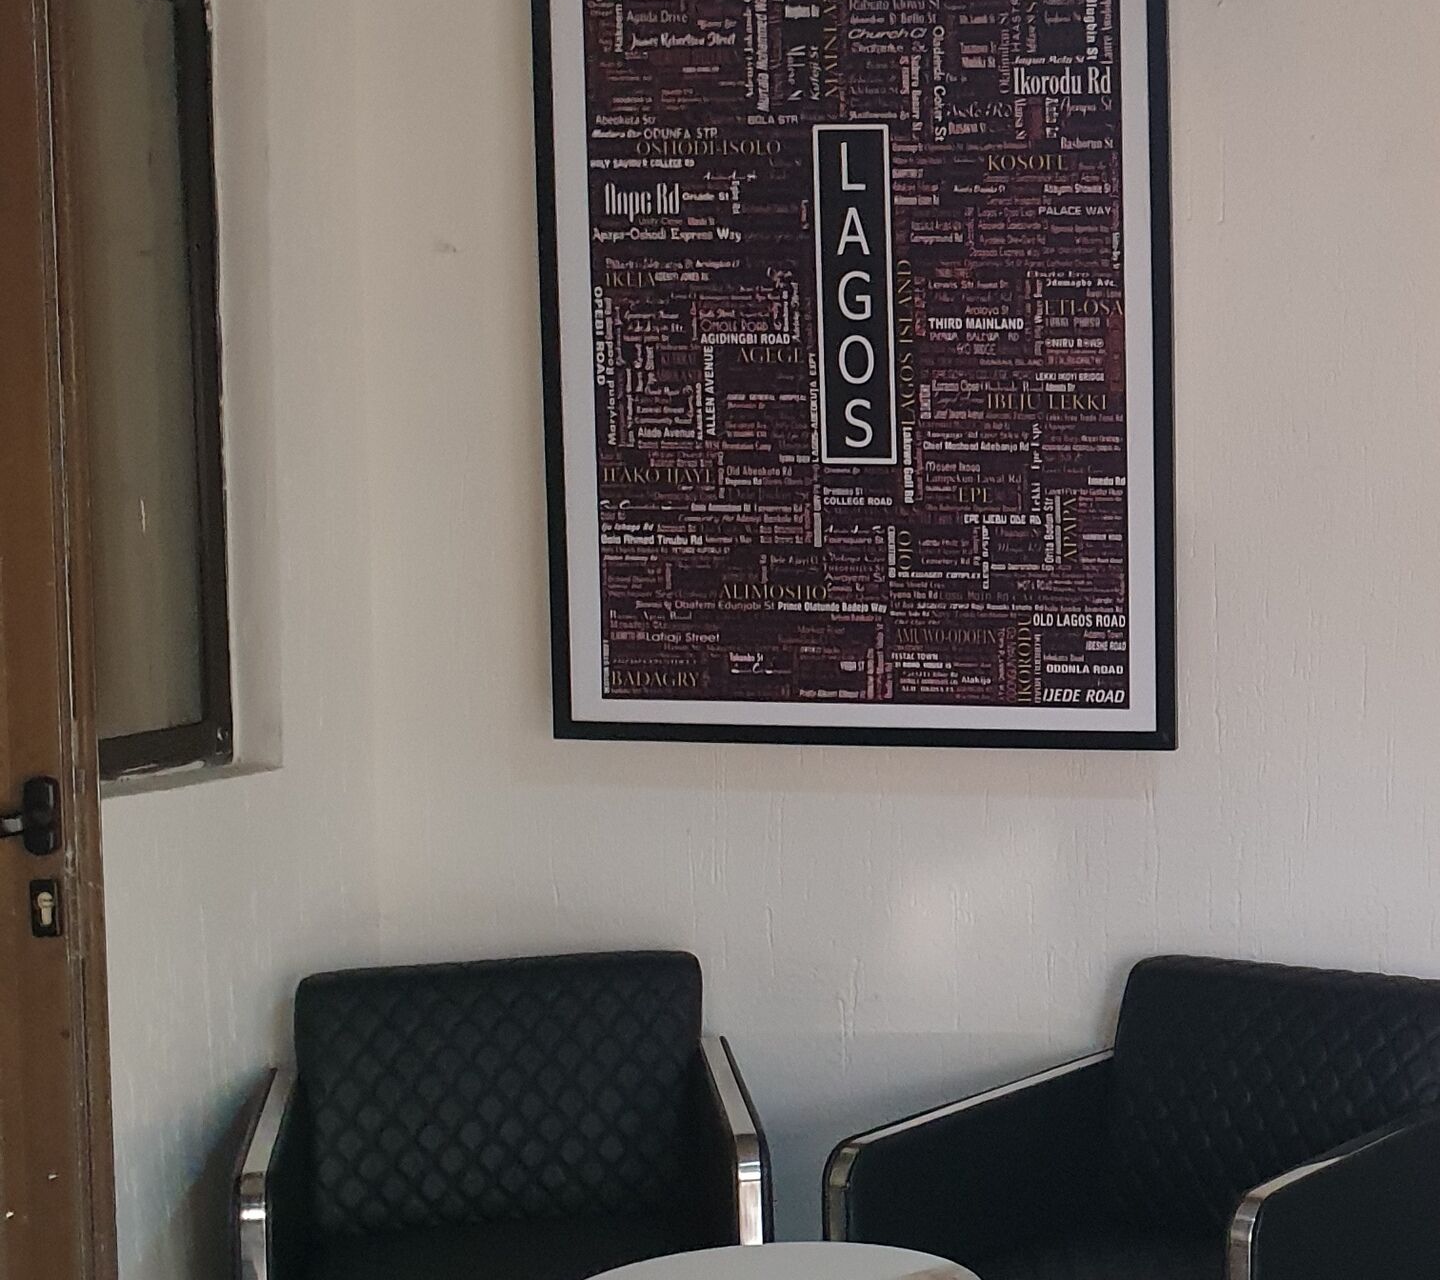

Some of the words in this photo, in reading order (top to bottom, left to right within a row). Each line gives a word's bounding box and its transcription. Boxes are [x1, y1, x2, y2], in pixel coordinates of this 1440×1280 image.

[848, 28, 909, 39] Church
[1013, 66, 1083, 96] Ikorodu
[1087, 66, 1114, 95] Rd
[656, 182, 681, 215] Rd
[1038, 206, 1083, 217] PALACE
[1086, 205, 1115, 216] WAY
[670, 228, 713, 243] Express
[716, 227, 742, 243] Way
[836, 141, 876, 449] LAGOS
[594, 286, 605, 336] OPEBI
[928, 317, 963, 331] THIRD
[965, 317, 1025, 331] MAINLAND
[700, 332, 757, 345] AGIDINGBI
[760, 331, 791, 345] ROAD
[595, 340, 607, 387] ROAD
[703, 345, 717, 394] AVENUE
[1048, 393, 1108, 410] LEKKI
[705, 397, 717, 437] ALLEN
[824, 496, 865, 507] COLLEGE
[867, 496, 893, 507] ROAD
[805, 600, 840, 613] Olatunde
[842, 600, 869, 614] Badejo
[871, 601, 888, 615] Way
[1033, 613, 1054, 629] OLD
[1056, 613, 1094, 629] LAGOS
[1096, 613, 1127, 629] ROAD
[685, 630, 720, 643] Street
[1093, 664, 1124, 675] ROAD
[610, 670, 700, 689] BADAGRY
[1042, 688, 1082, 704] IJEDE
[1085, 688, 1126, 705] ROAD
